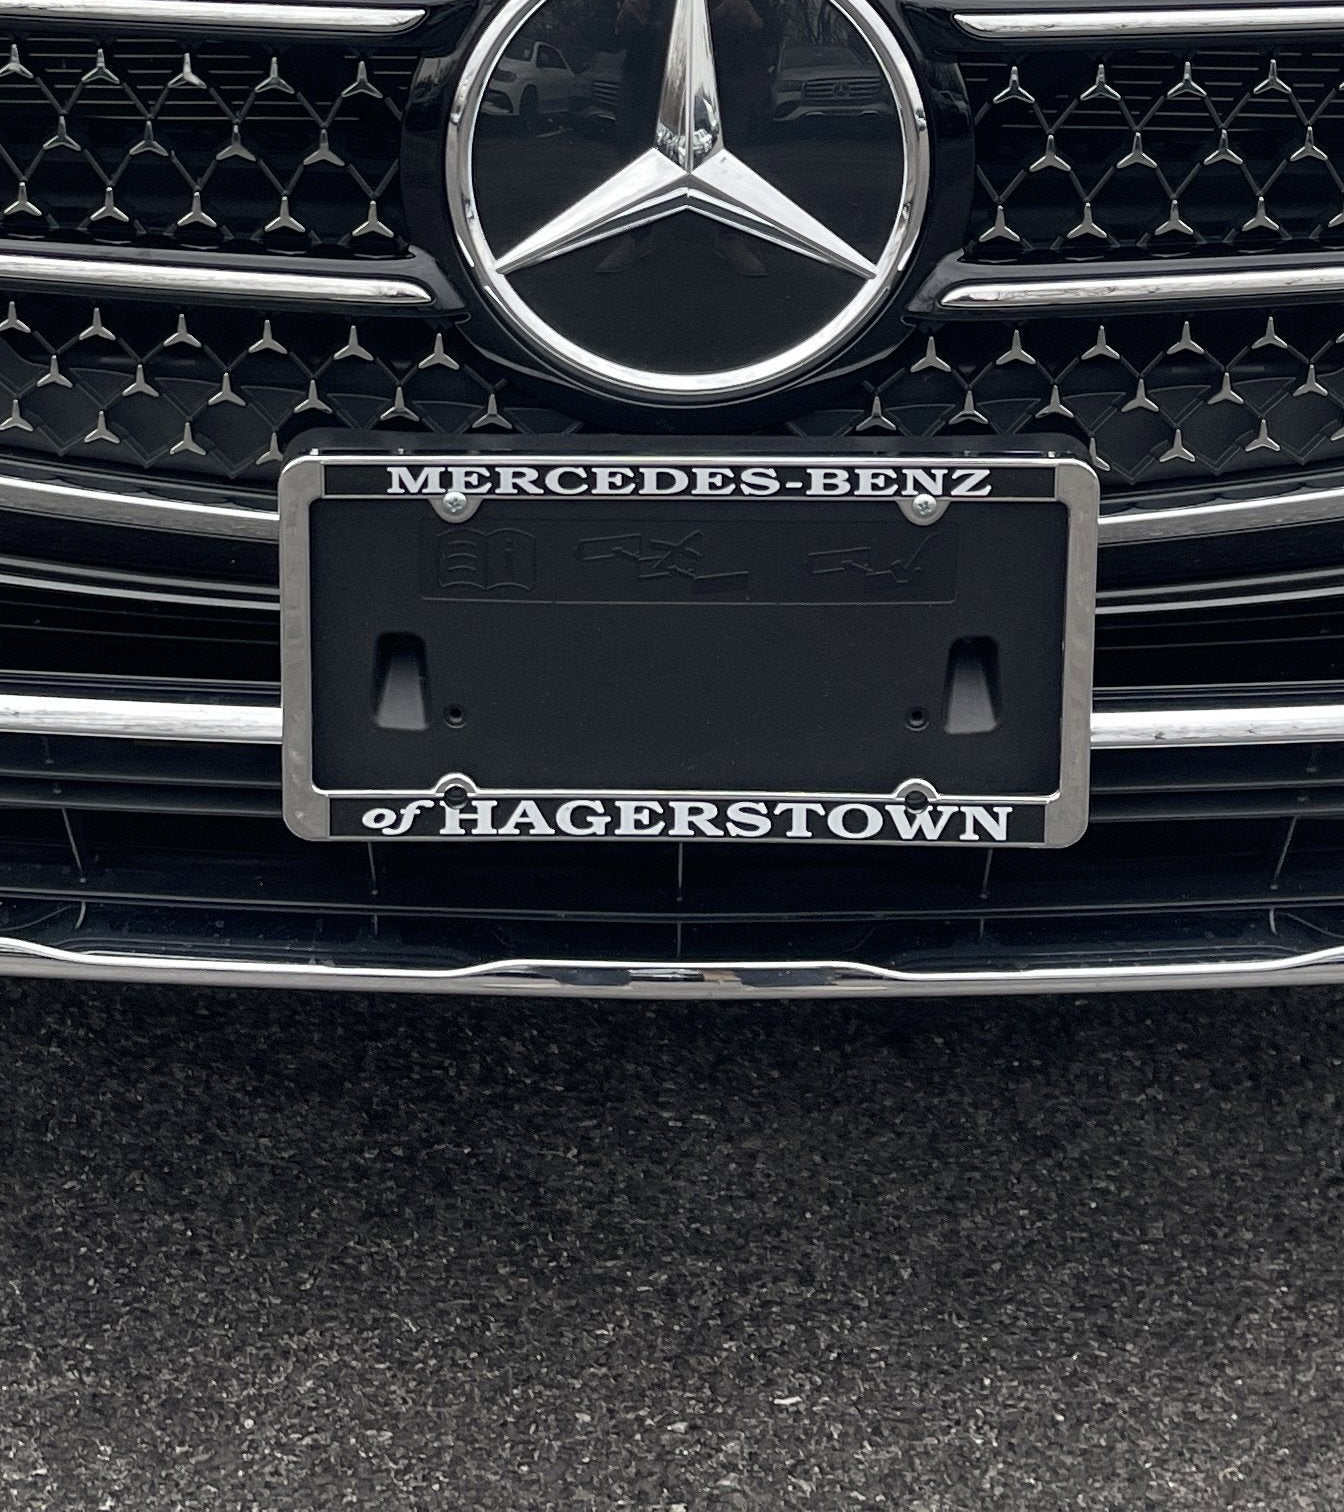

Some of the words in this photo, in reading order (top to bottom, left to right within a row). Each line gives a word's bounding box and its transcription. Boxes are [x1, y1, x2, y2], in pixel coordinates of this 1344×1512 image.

[386, 466, 992, 497] MERCEDES-BENZ
[361, 799, 435, 836] of
[439, 799, 1013, 841] HAGERSTOWN
